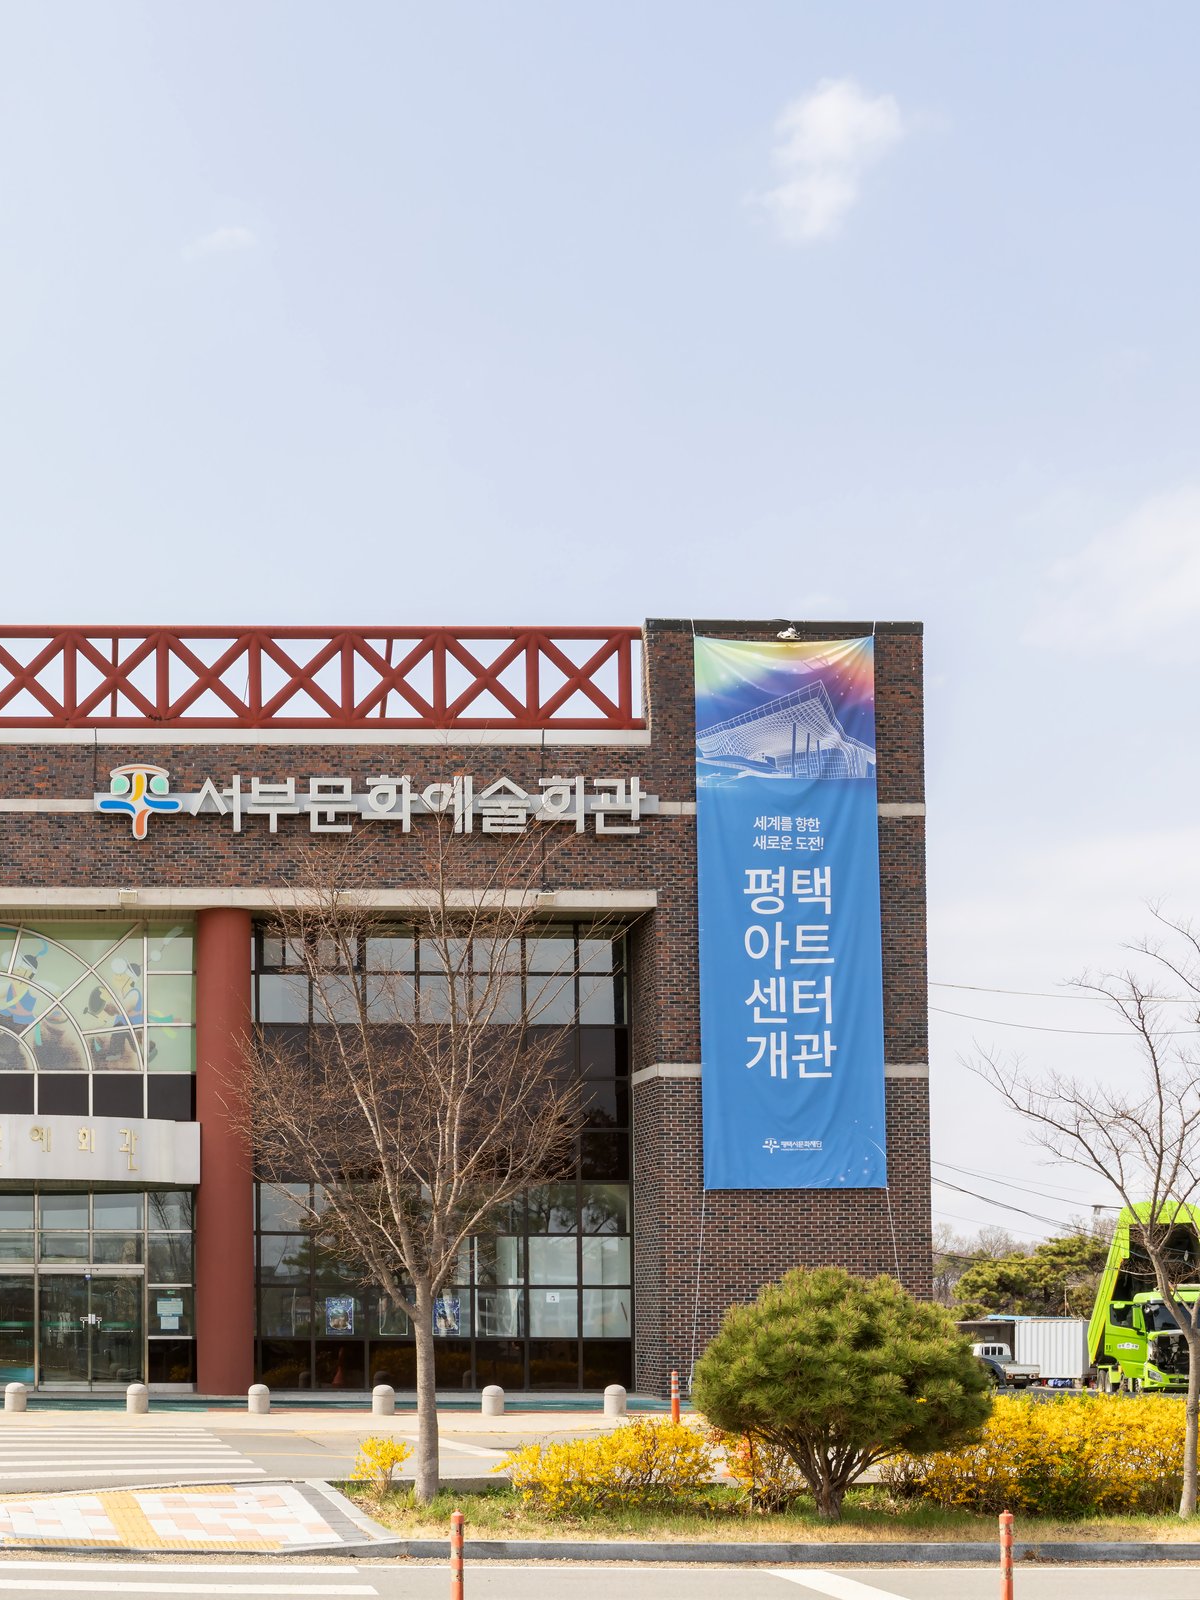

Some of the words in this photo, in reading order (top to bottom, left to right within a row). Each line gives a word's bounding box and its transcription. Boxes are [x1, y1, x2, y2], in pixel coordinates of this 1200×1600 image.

[189, 774, 648, 835] 서부문화예술회관
[753, 815, 793, 832] 세계를
[795, 816, 821, 833] 향한
[752, 834, 793, 851] 새로운
[795, 836, 825, 851] 도전!
[743, 866, 832, 915] 평택
[744, 921, 835, 970] 아트
[744, 976, 833, 1024] 센터
[745, 1030, 838, 1080] 개관
